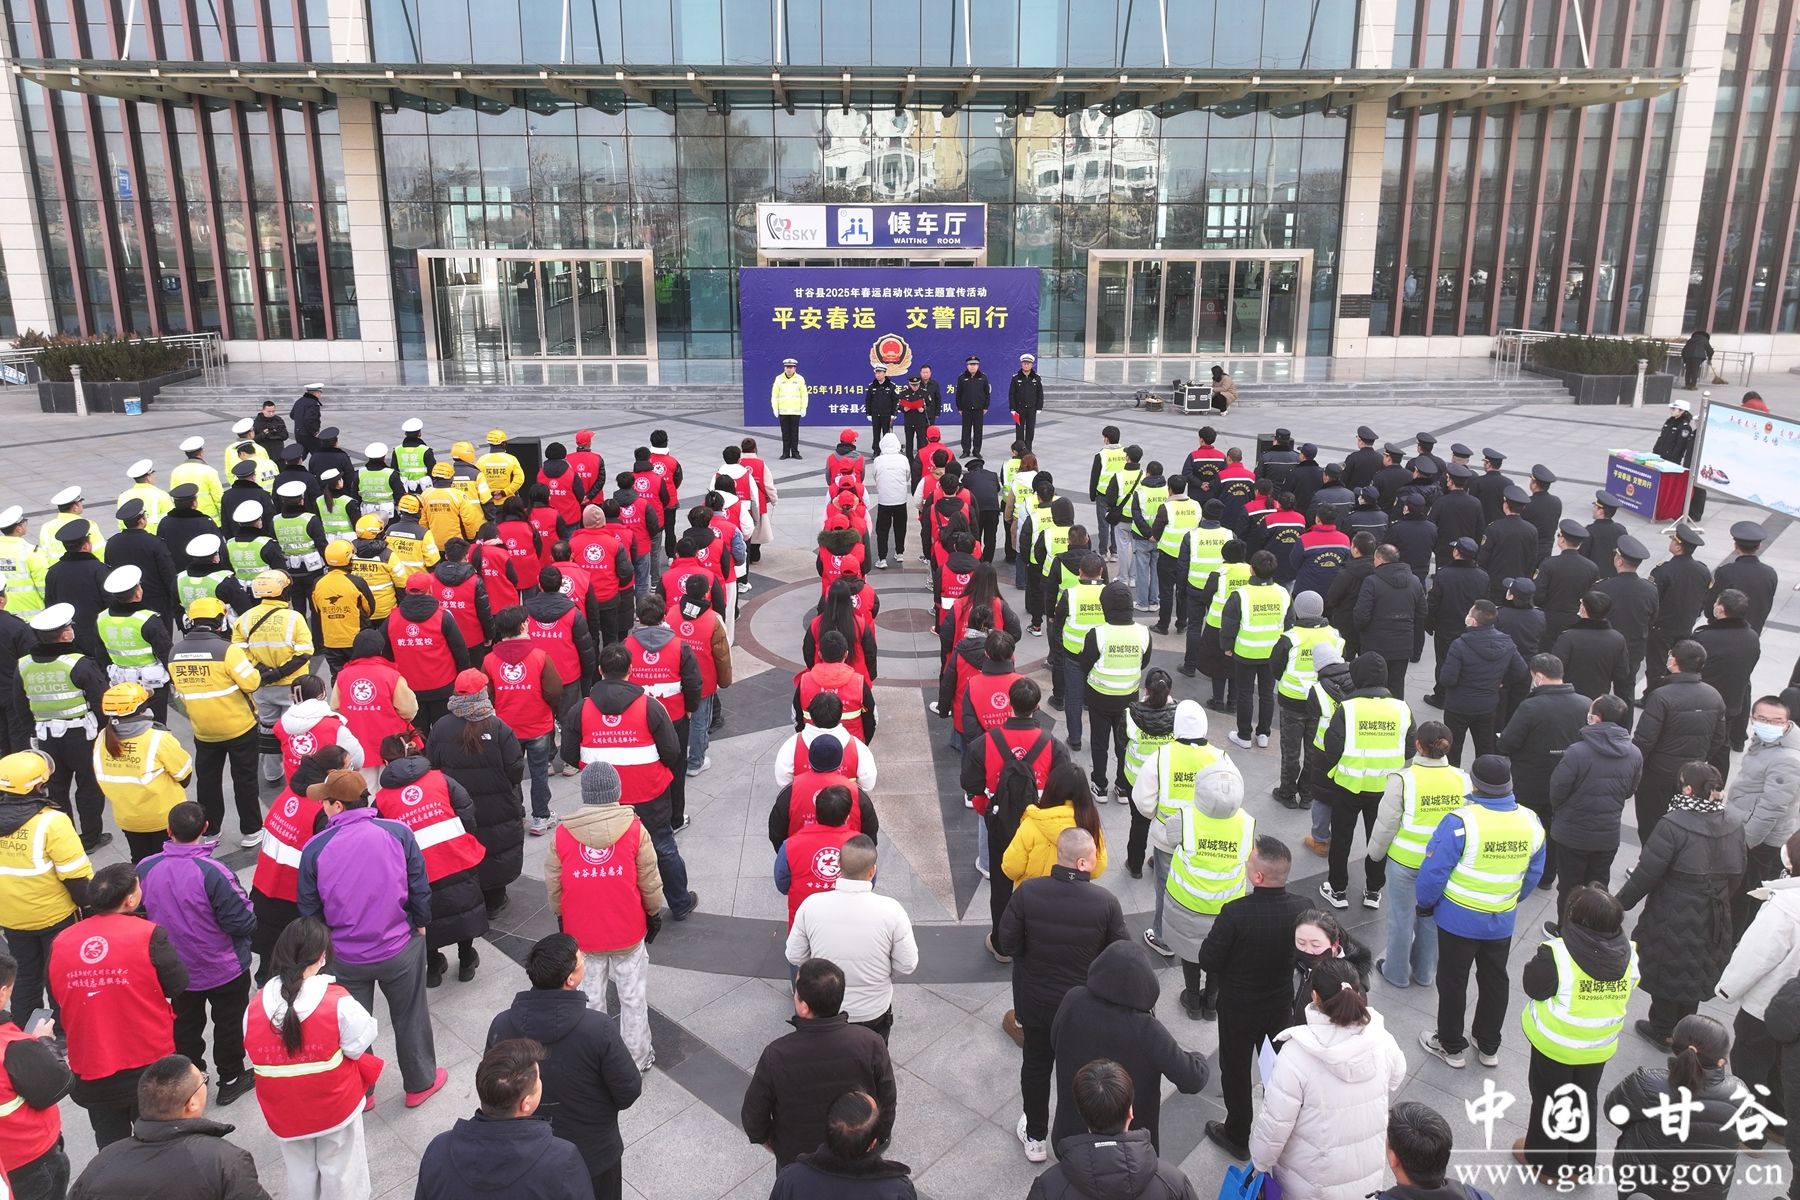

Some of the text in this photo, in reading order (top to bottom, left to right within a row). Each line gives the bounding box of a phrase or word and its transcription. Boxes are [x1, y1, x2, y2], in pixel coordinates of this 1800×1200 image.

[888, 211, 967, 235] 候车厅
[783, 229, 818, 241] GSKY
[794, 287, 987, 298] 甘谷县2025年春运启动仪式主题宣传活动
[772, 306, 1008, 329] 平安春运 交警同行
[483, 569, 499, 577] 驾校
[441, 601, 466, 609] 龙驾校
[28, 683, 69, 693] POLICE
[1173, 771, 1197, 783] 冀城
[572, 864, 624, 878] 甘谷县志愿者
